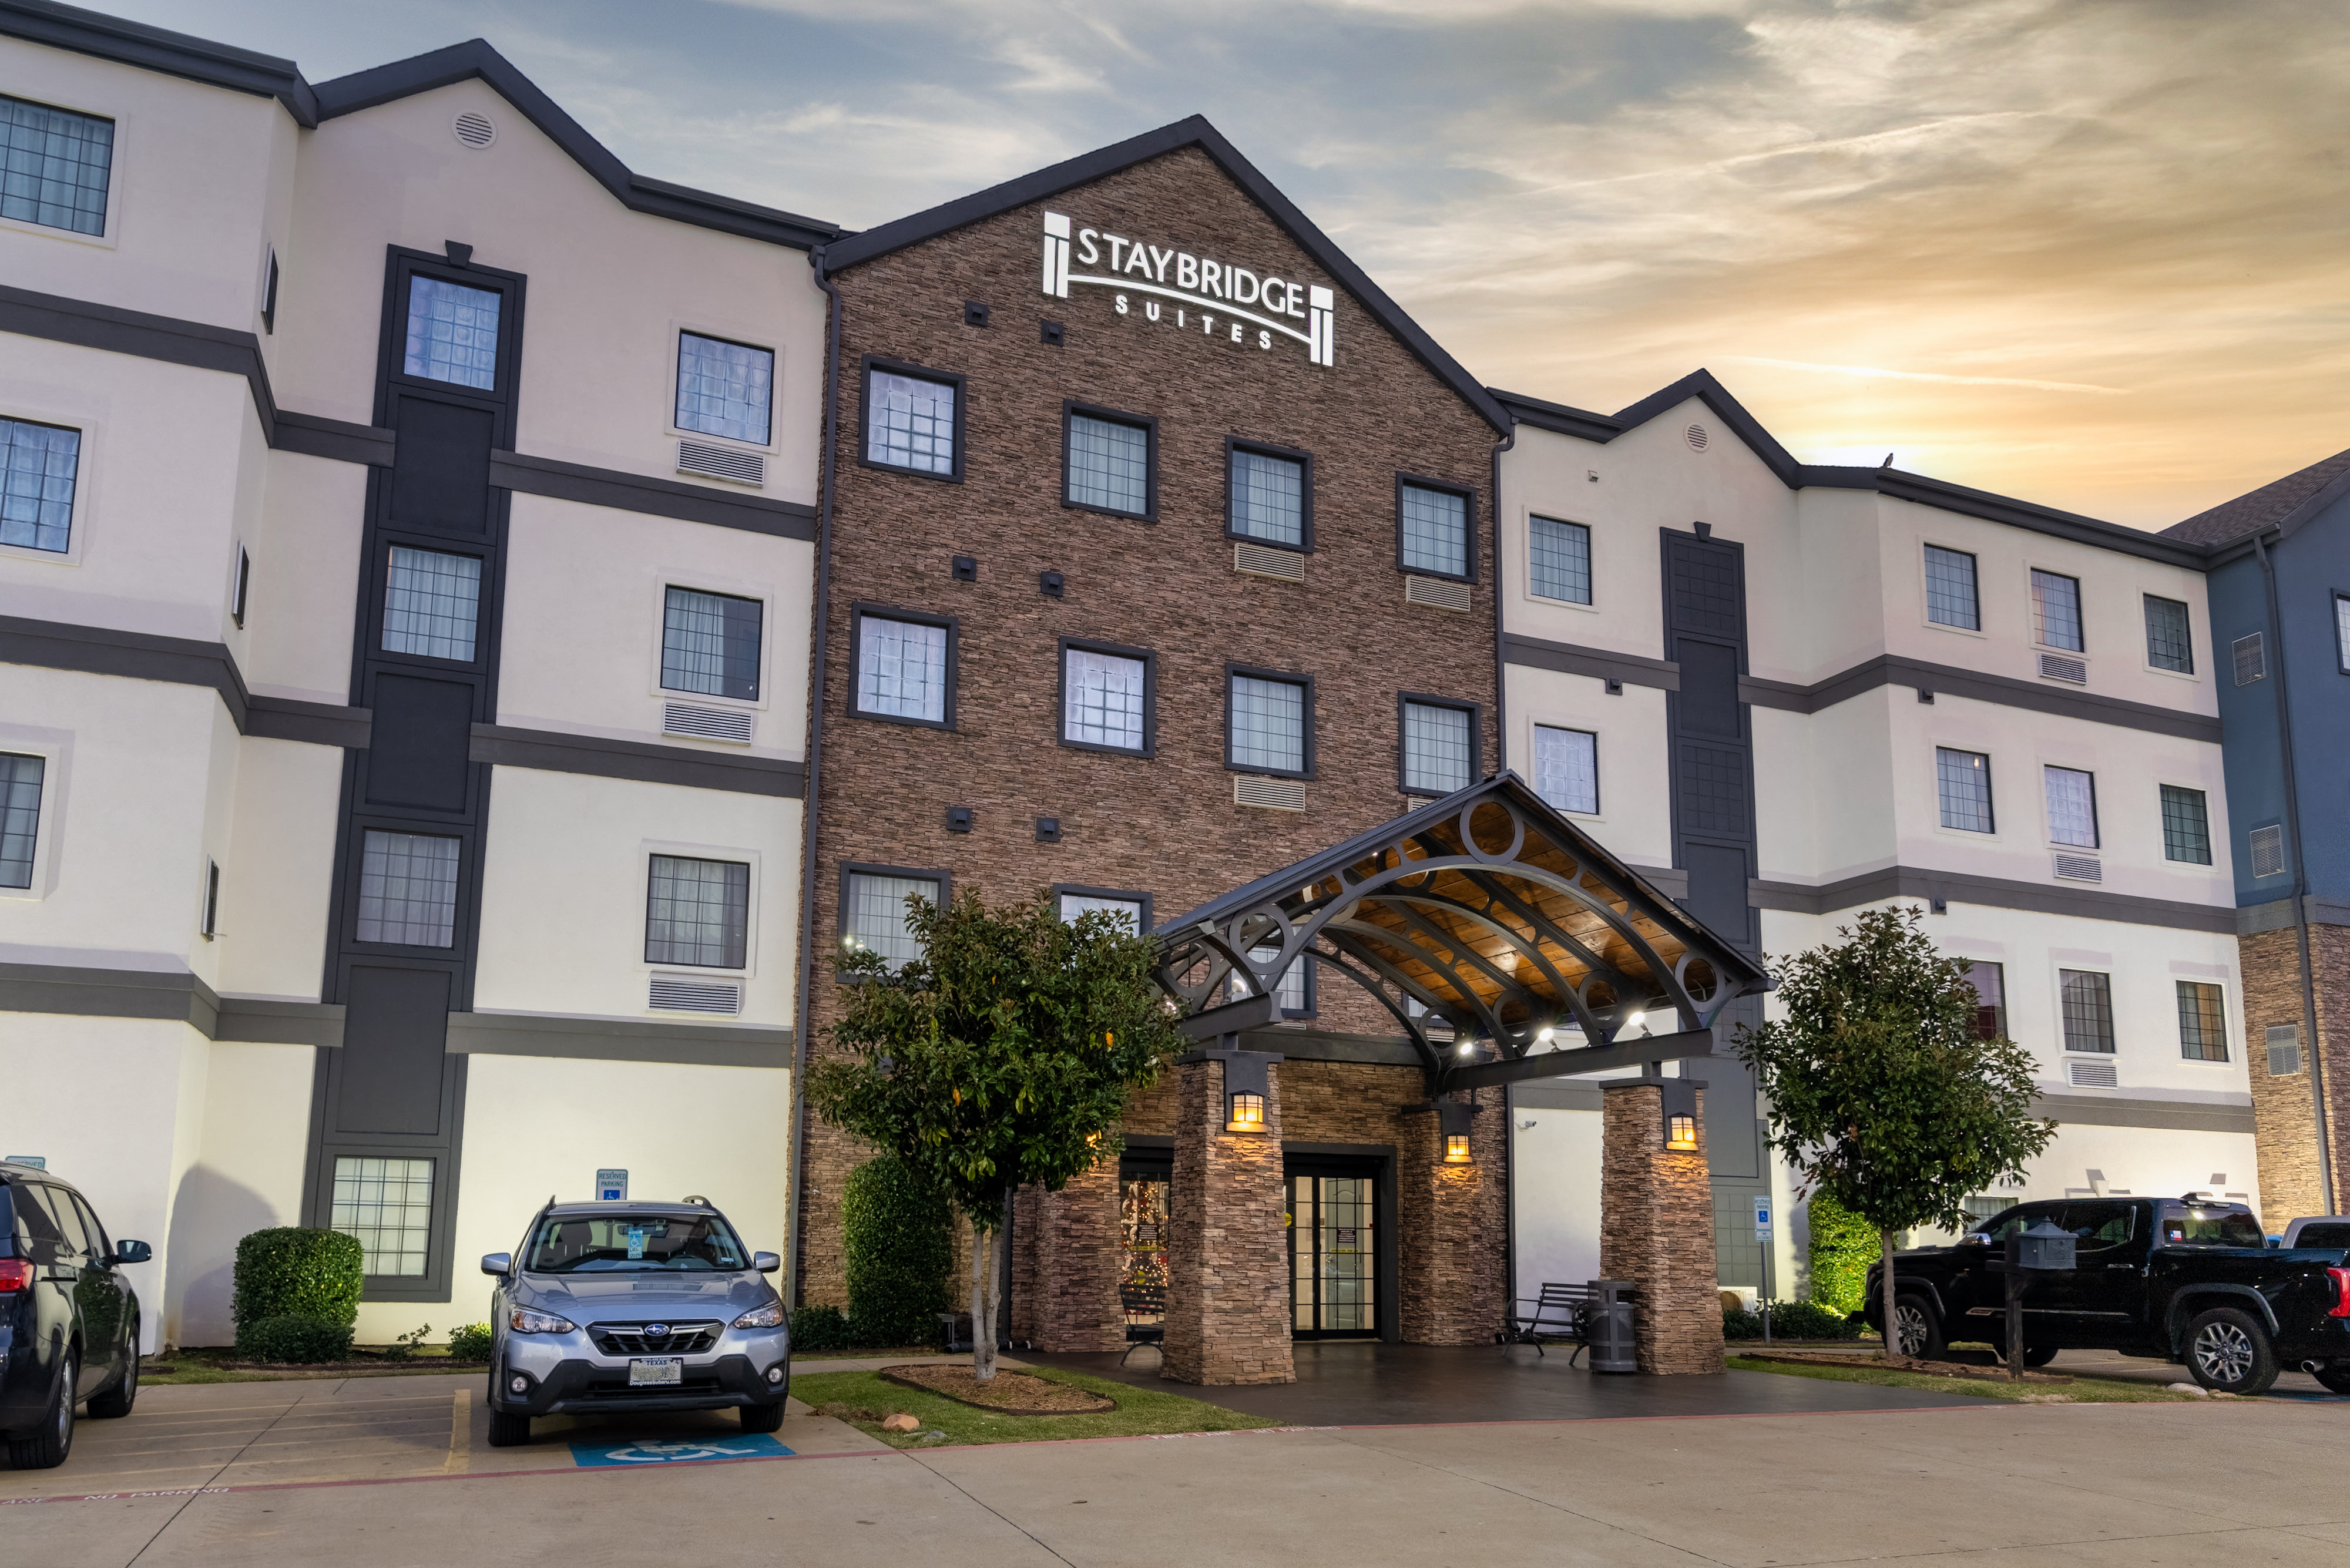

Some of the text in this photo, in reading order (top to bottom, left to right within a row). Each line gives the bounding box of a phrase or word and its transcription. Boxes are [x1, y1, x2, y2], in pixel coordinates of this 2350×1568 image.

[1077, 229, 1305, 318] STAYBRIDGE
[1115, 295, 1271, 350] SUITES
[130, 1488, 229, 1498] PARKING
